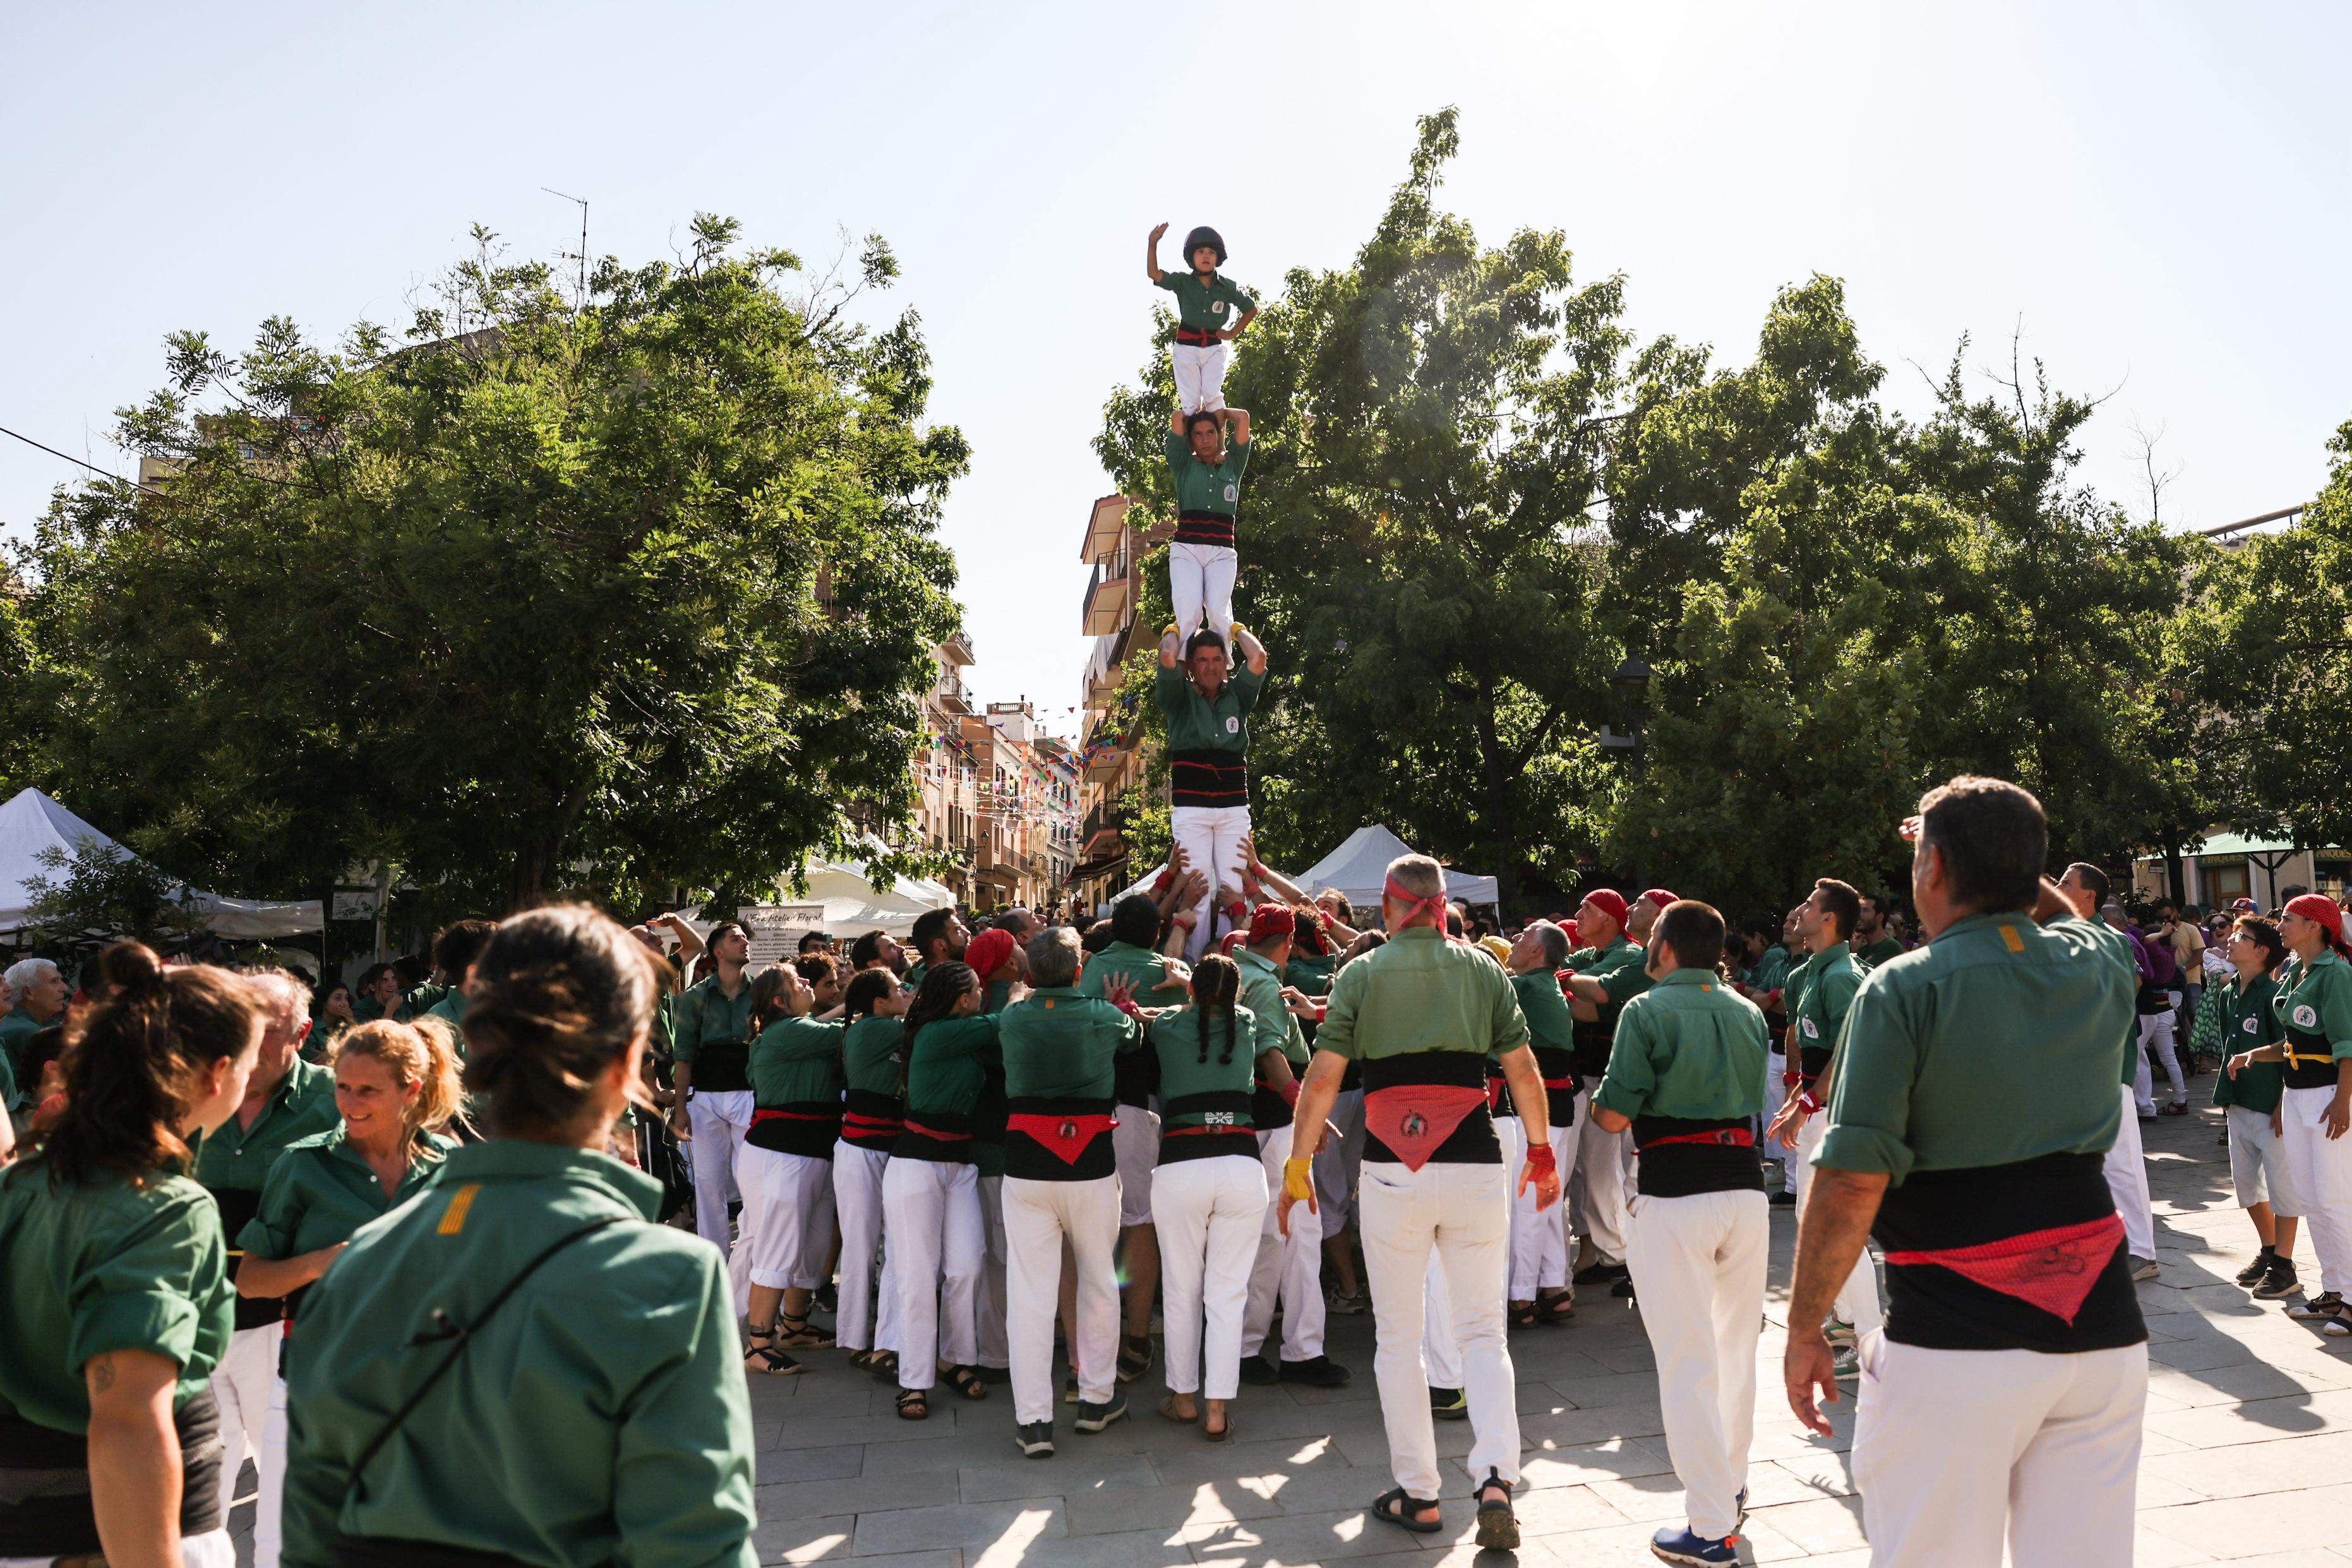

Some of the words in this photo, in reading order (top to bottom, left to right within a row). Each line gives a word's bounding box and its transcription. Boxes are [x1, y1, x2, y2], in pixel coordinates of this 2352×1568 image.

[744, 914, 766, 922] L'Era
[768, 913, 795, 922] Atelier
[797, 913, 822, 921] Floral
